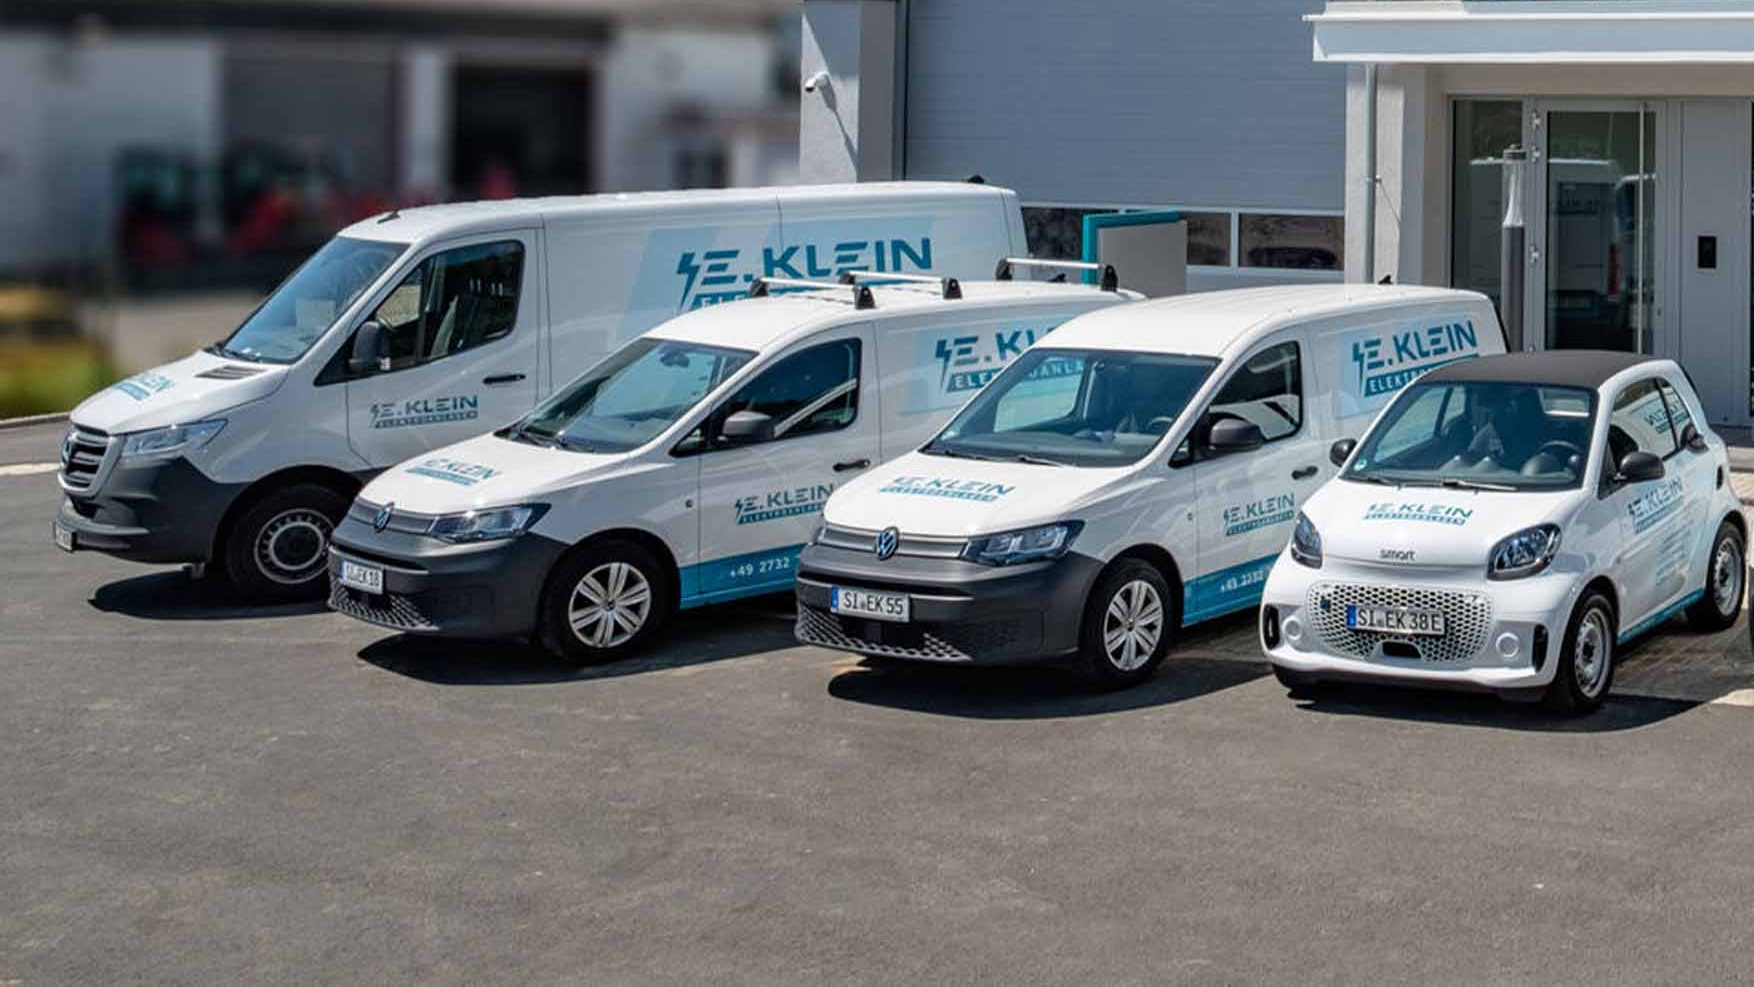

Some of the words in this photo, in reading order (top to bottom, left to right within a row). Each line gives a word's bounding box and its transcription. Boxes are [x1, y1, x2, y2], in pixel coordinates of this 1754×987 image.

[1363, 319, 1477, 370] E.KLEIN
[844, 592, 859, 609] SI
[1358, 609, 1375, 627] SI
